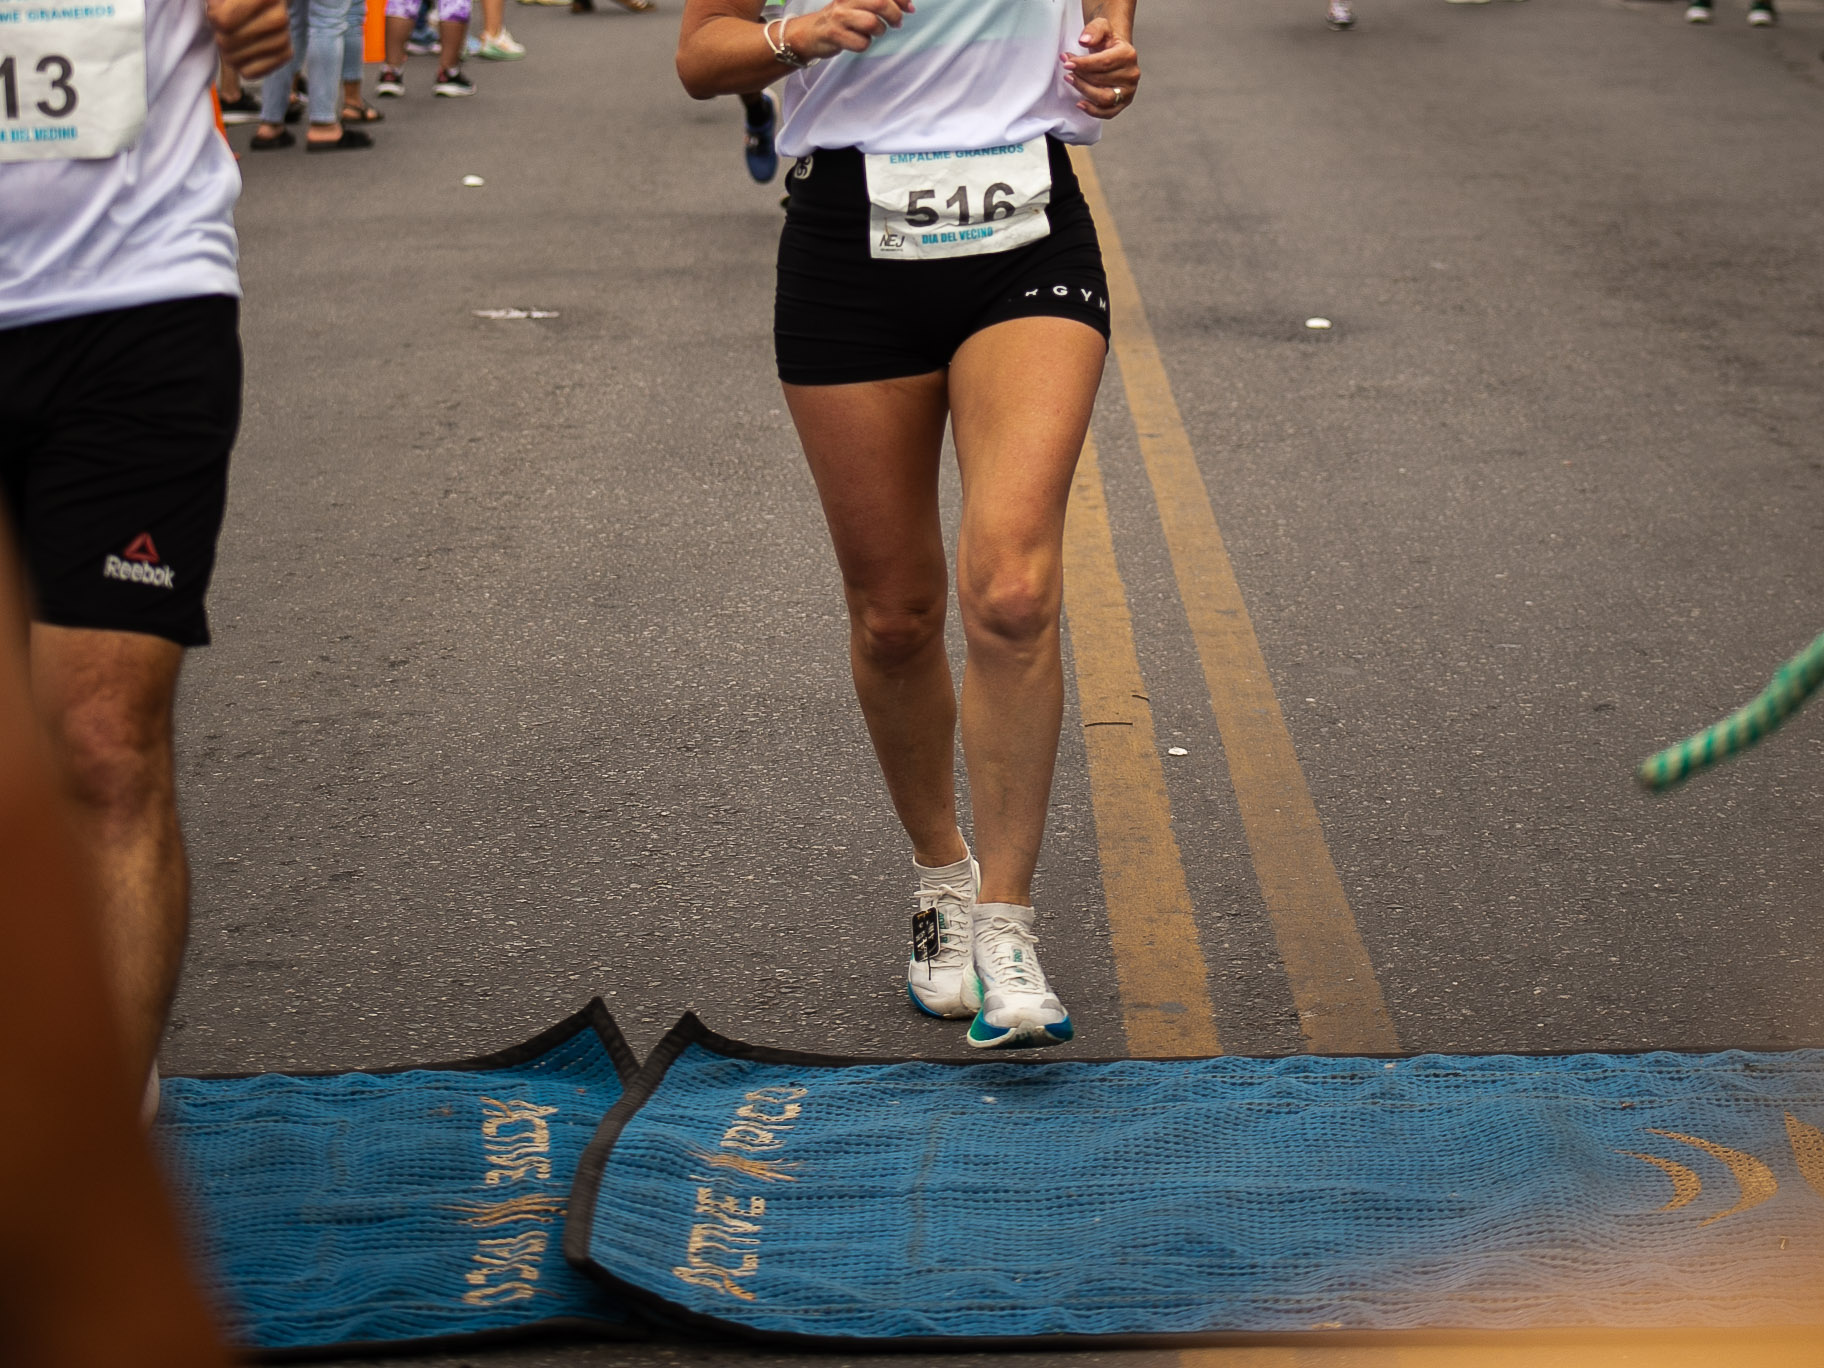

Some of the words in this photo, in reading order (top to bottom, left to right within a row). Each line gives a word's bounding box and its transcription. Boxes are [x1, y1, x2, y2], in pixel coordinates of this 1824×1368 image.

[889, 150, 951, 164] EMPALME
[905, 182, 1016, 227] 516
[879, 234, 905, 247] NEJ
[922, 234, 939, 244] DIA
[941, 232, 957, 243] DEL
[959, 227, 993, 241] VECINO
[104, 554, 175, 589] Reebok
